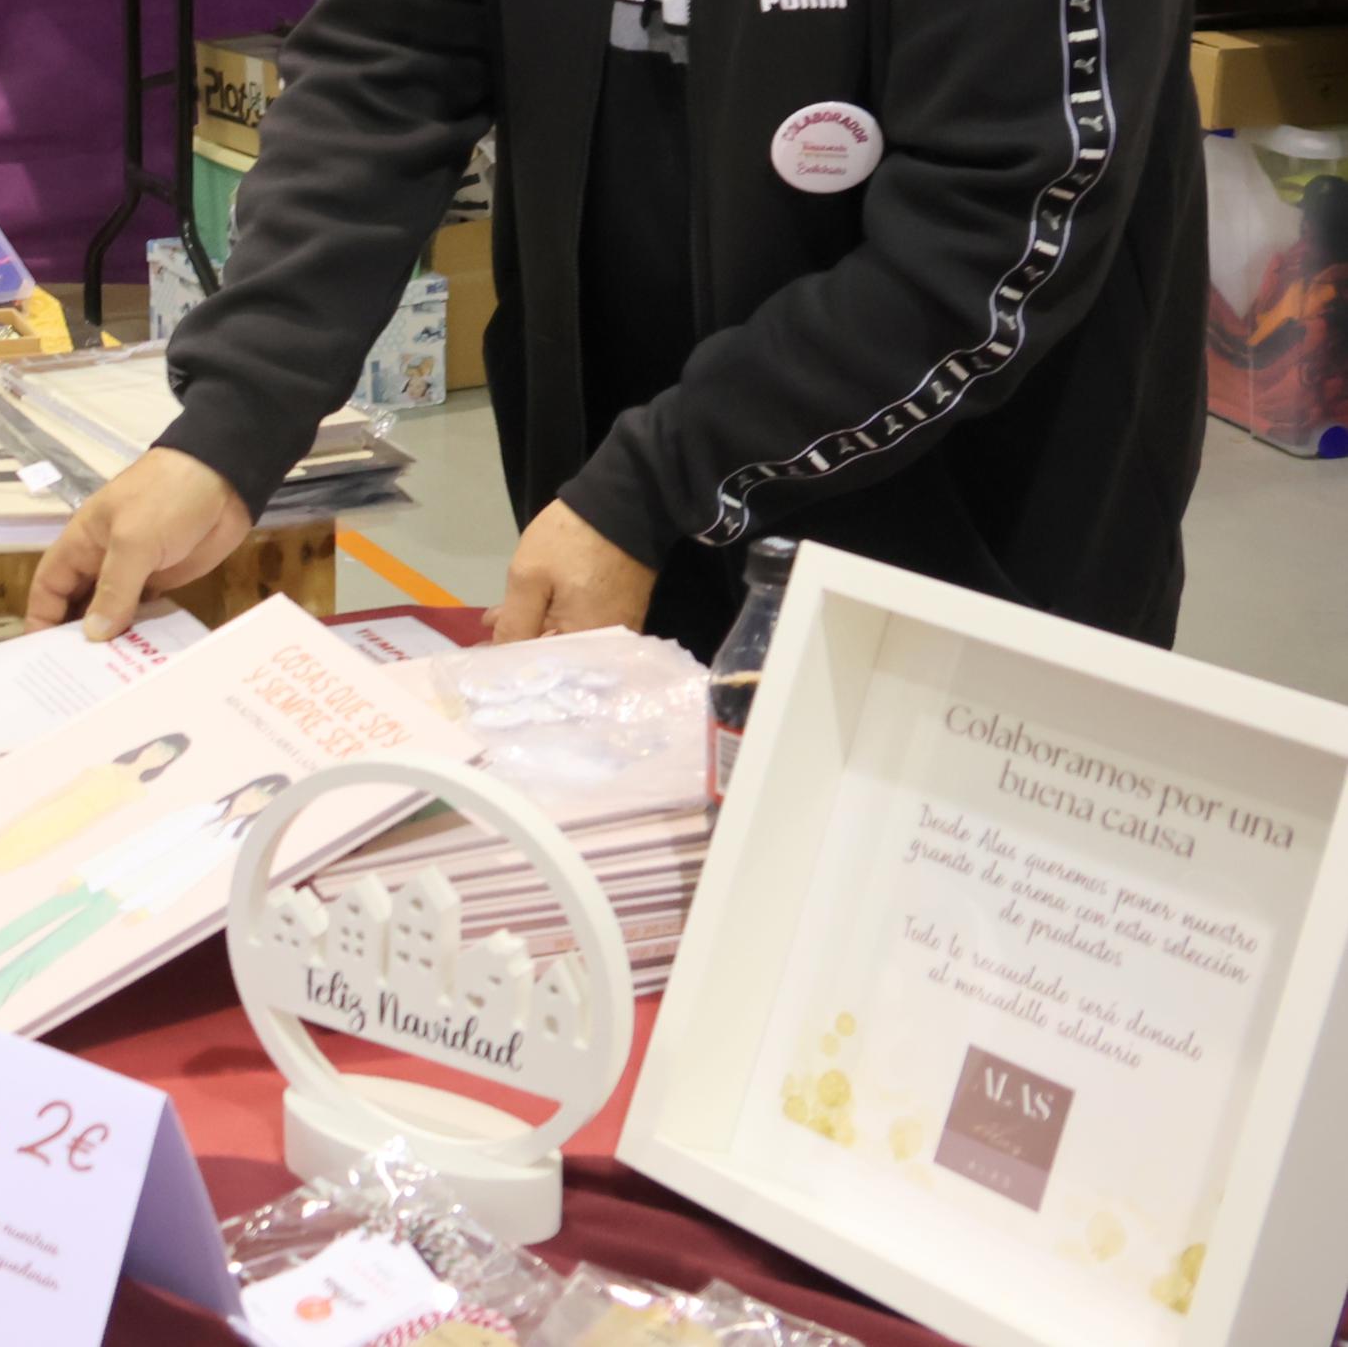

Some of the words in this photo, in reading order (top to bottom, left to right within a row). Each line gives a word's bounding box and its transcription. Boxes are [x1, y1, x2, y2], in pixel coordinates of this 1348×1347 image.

[782, 111, 868, 143] COLABORADOR
[255, 677, 334, 735] SIEMPRE
[317, 726, 366, 760] SER
[271, 644, 339, 695] COSAS
[325, 684, 375, 723] QUE
[358, 712, 413, 750] SOY
[944, 704, 1154, 800] Colaboramos
[1157, 784, 1223, 823] por
[1229, 807, 1295, 850] una
[998, 758, 1095, 823] buena
[1101, 808, 1197, 859] causa
[919, 803, 971, 842] Desde
[977, 827, 1017, 860] Alas
[1025, 853, 1107, 895] queremos
[1112, 887, 1176, 921] poner
[1182, 914, 1258, 953] nuestro
[981, 860, 1007, 887] de
[1011, 880, 1070, 912] arena
[1075, 905, 1110, 928] con
[1163, 934, 1250, 985] selección
[999, 899, 1025, 926] de
[1025, 918, 1122, 967] productos
[305, 966, 367, 1032] Feliz
[377, 990, 524, 1072] Navidad
[904, 914, 942, 950] Todo
[948, 932, 964, 960] lo
[972, 952, 1069, 1004] recaudado
[1078, 996, 1121, 1027] será
[1125, 1008, 1203, 1062] donado
[927, 961, 951, 984] al
[954, 977, 1048, 1028] mercadillo
[1057, 1018, 1141, 1069] solidario
[16, 1099, 110, 1172] 2€
